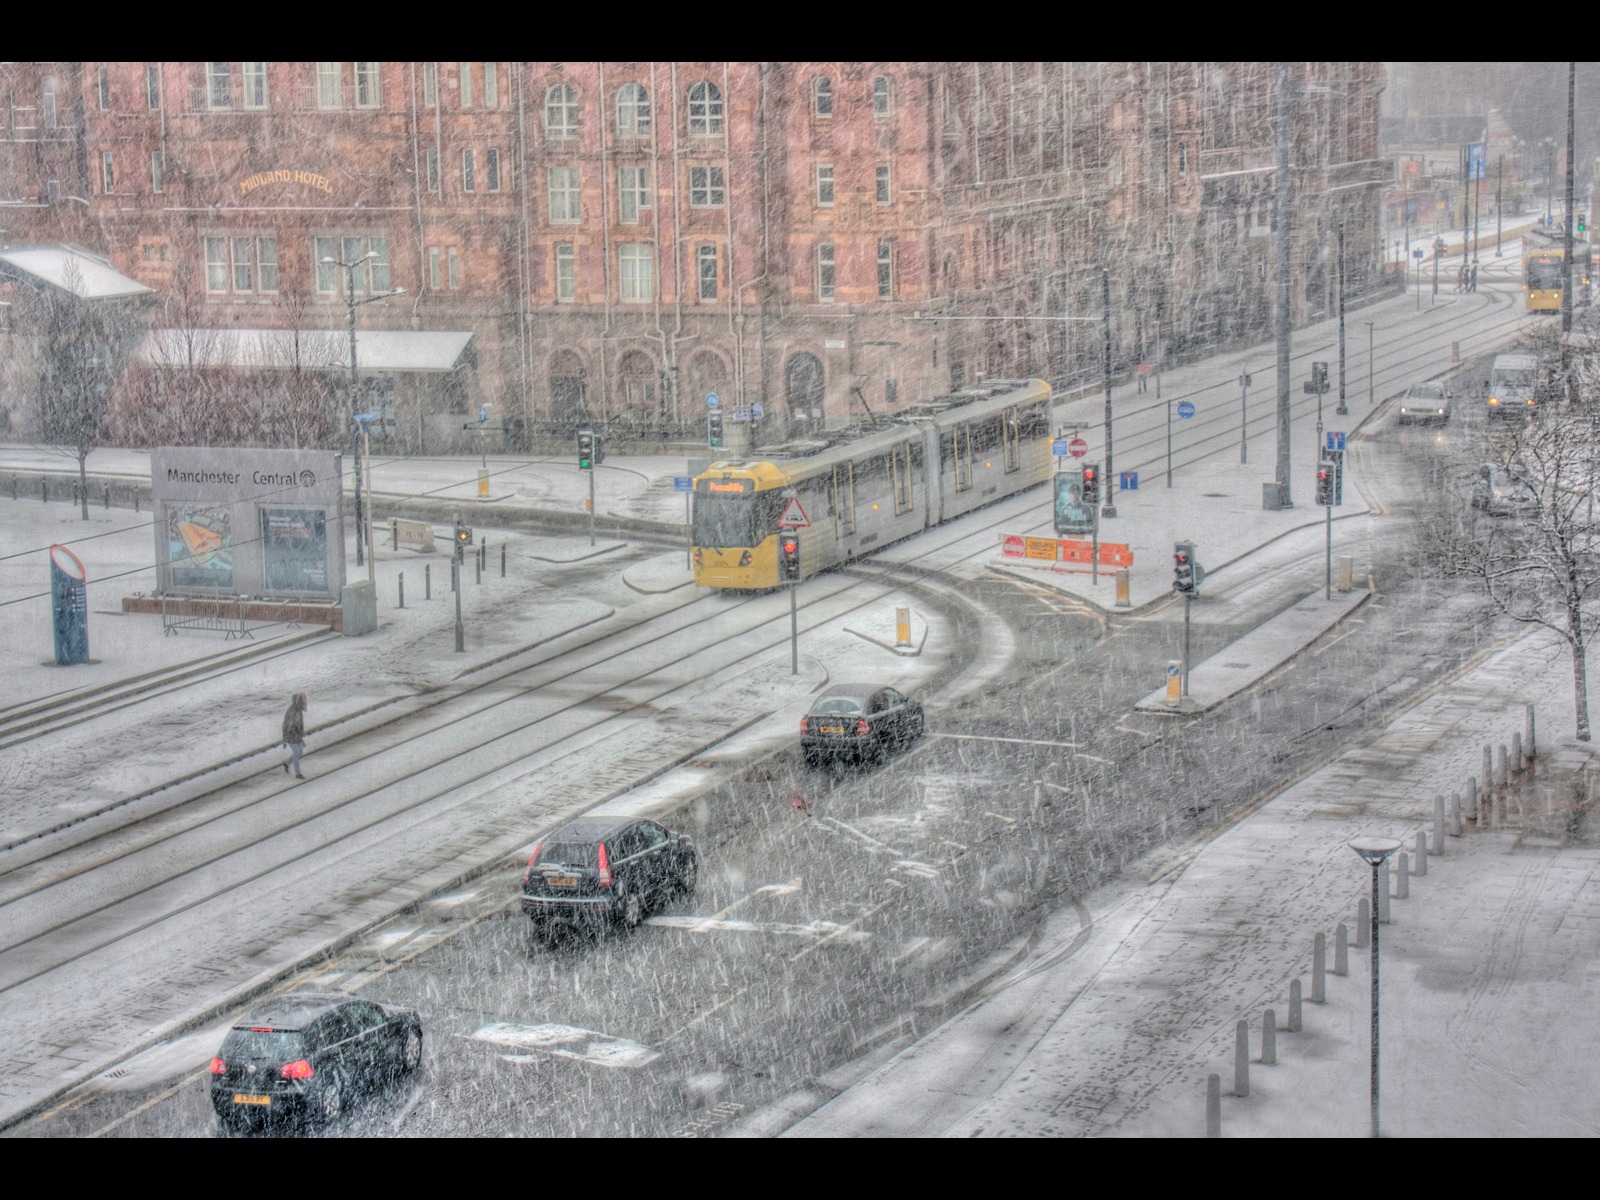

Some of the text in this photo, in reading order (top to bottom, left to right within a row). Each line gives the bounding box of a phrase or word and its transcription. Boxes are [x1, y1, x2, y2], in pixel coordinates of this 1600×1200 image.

[240, 169, 333, 194] MIDLAND HOTEL
[167, 468, 297, 486] Manchester Central
